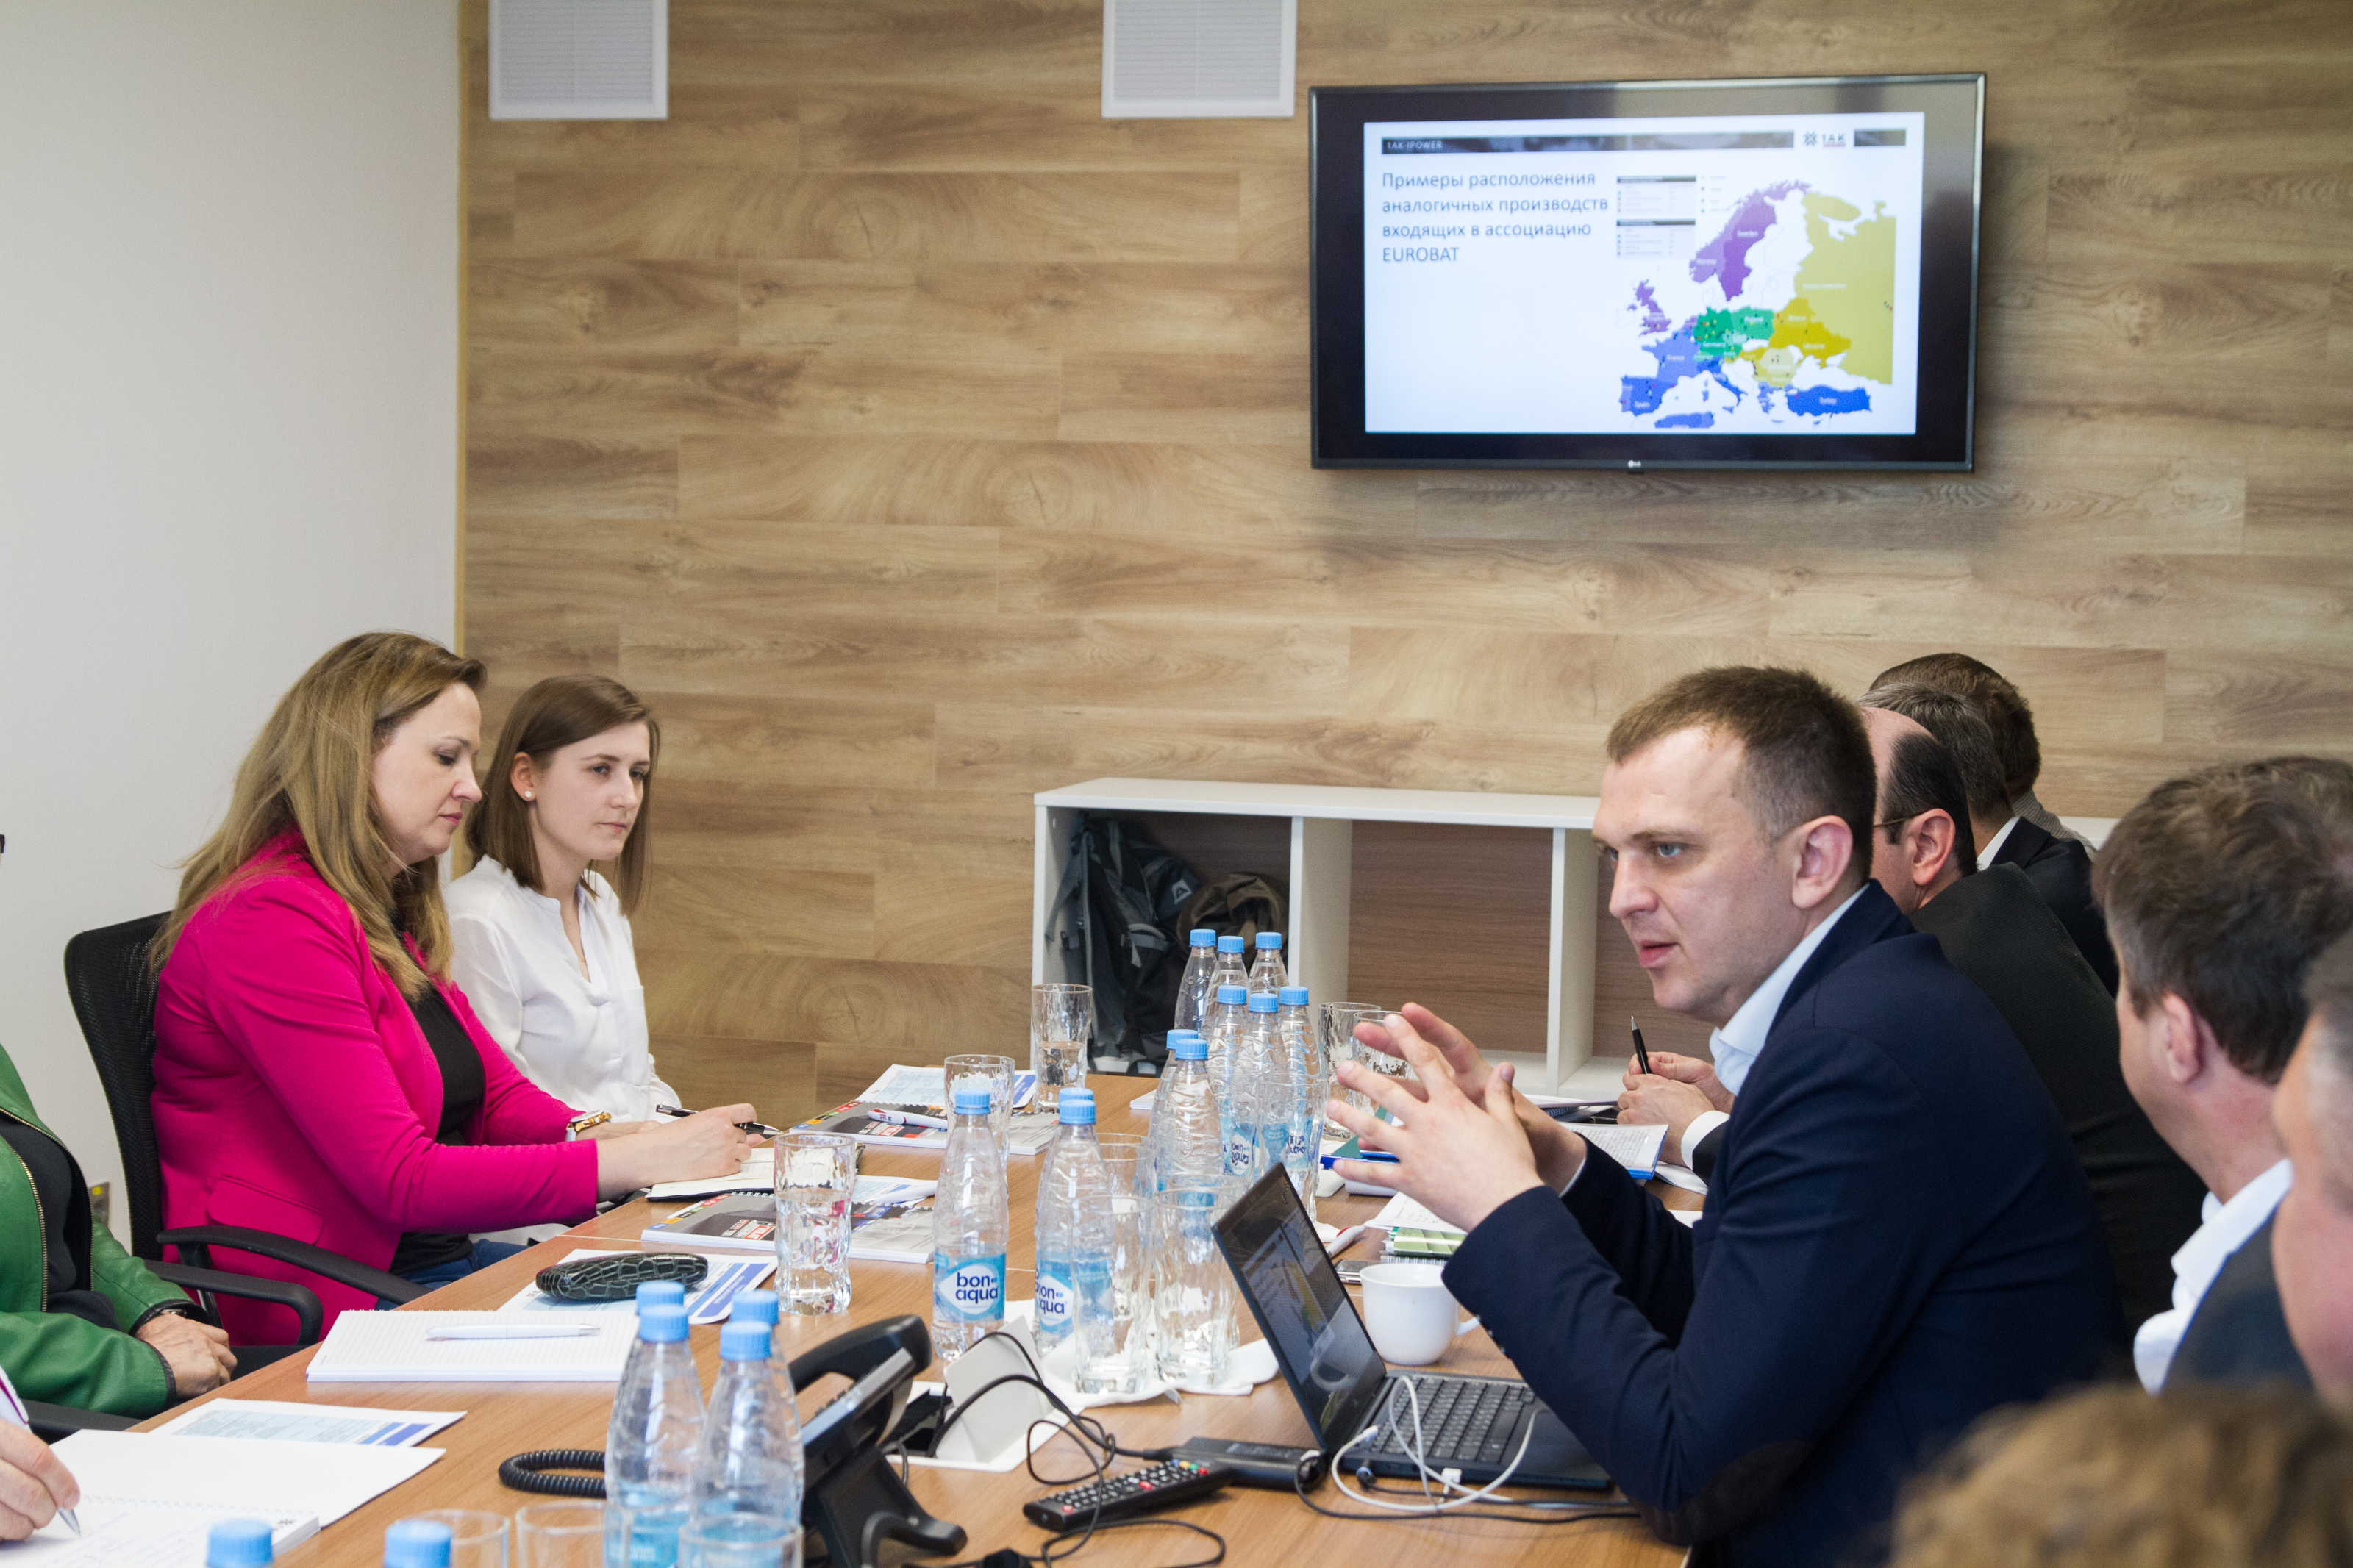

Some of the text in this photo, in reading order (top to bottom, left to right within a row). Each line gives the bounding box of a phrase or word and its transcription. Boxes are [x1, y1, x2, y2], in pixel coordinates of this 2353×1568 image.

[1382, 173, 1596, 190] Примеры расположения
[1382, 199, 1493, 212] аналогичных
[1499, 198, 1609, 214] производств
[1383, 223, 1591, 240] входящих в ассоциацию
[1382, 247, 1460, 262] EUROBAT
[957, 1272, 990, 1287] bon
[955, 1287, 999, 1304] aqua
[1039, 1299, 1065, 1315] qua
